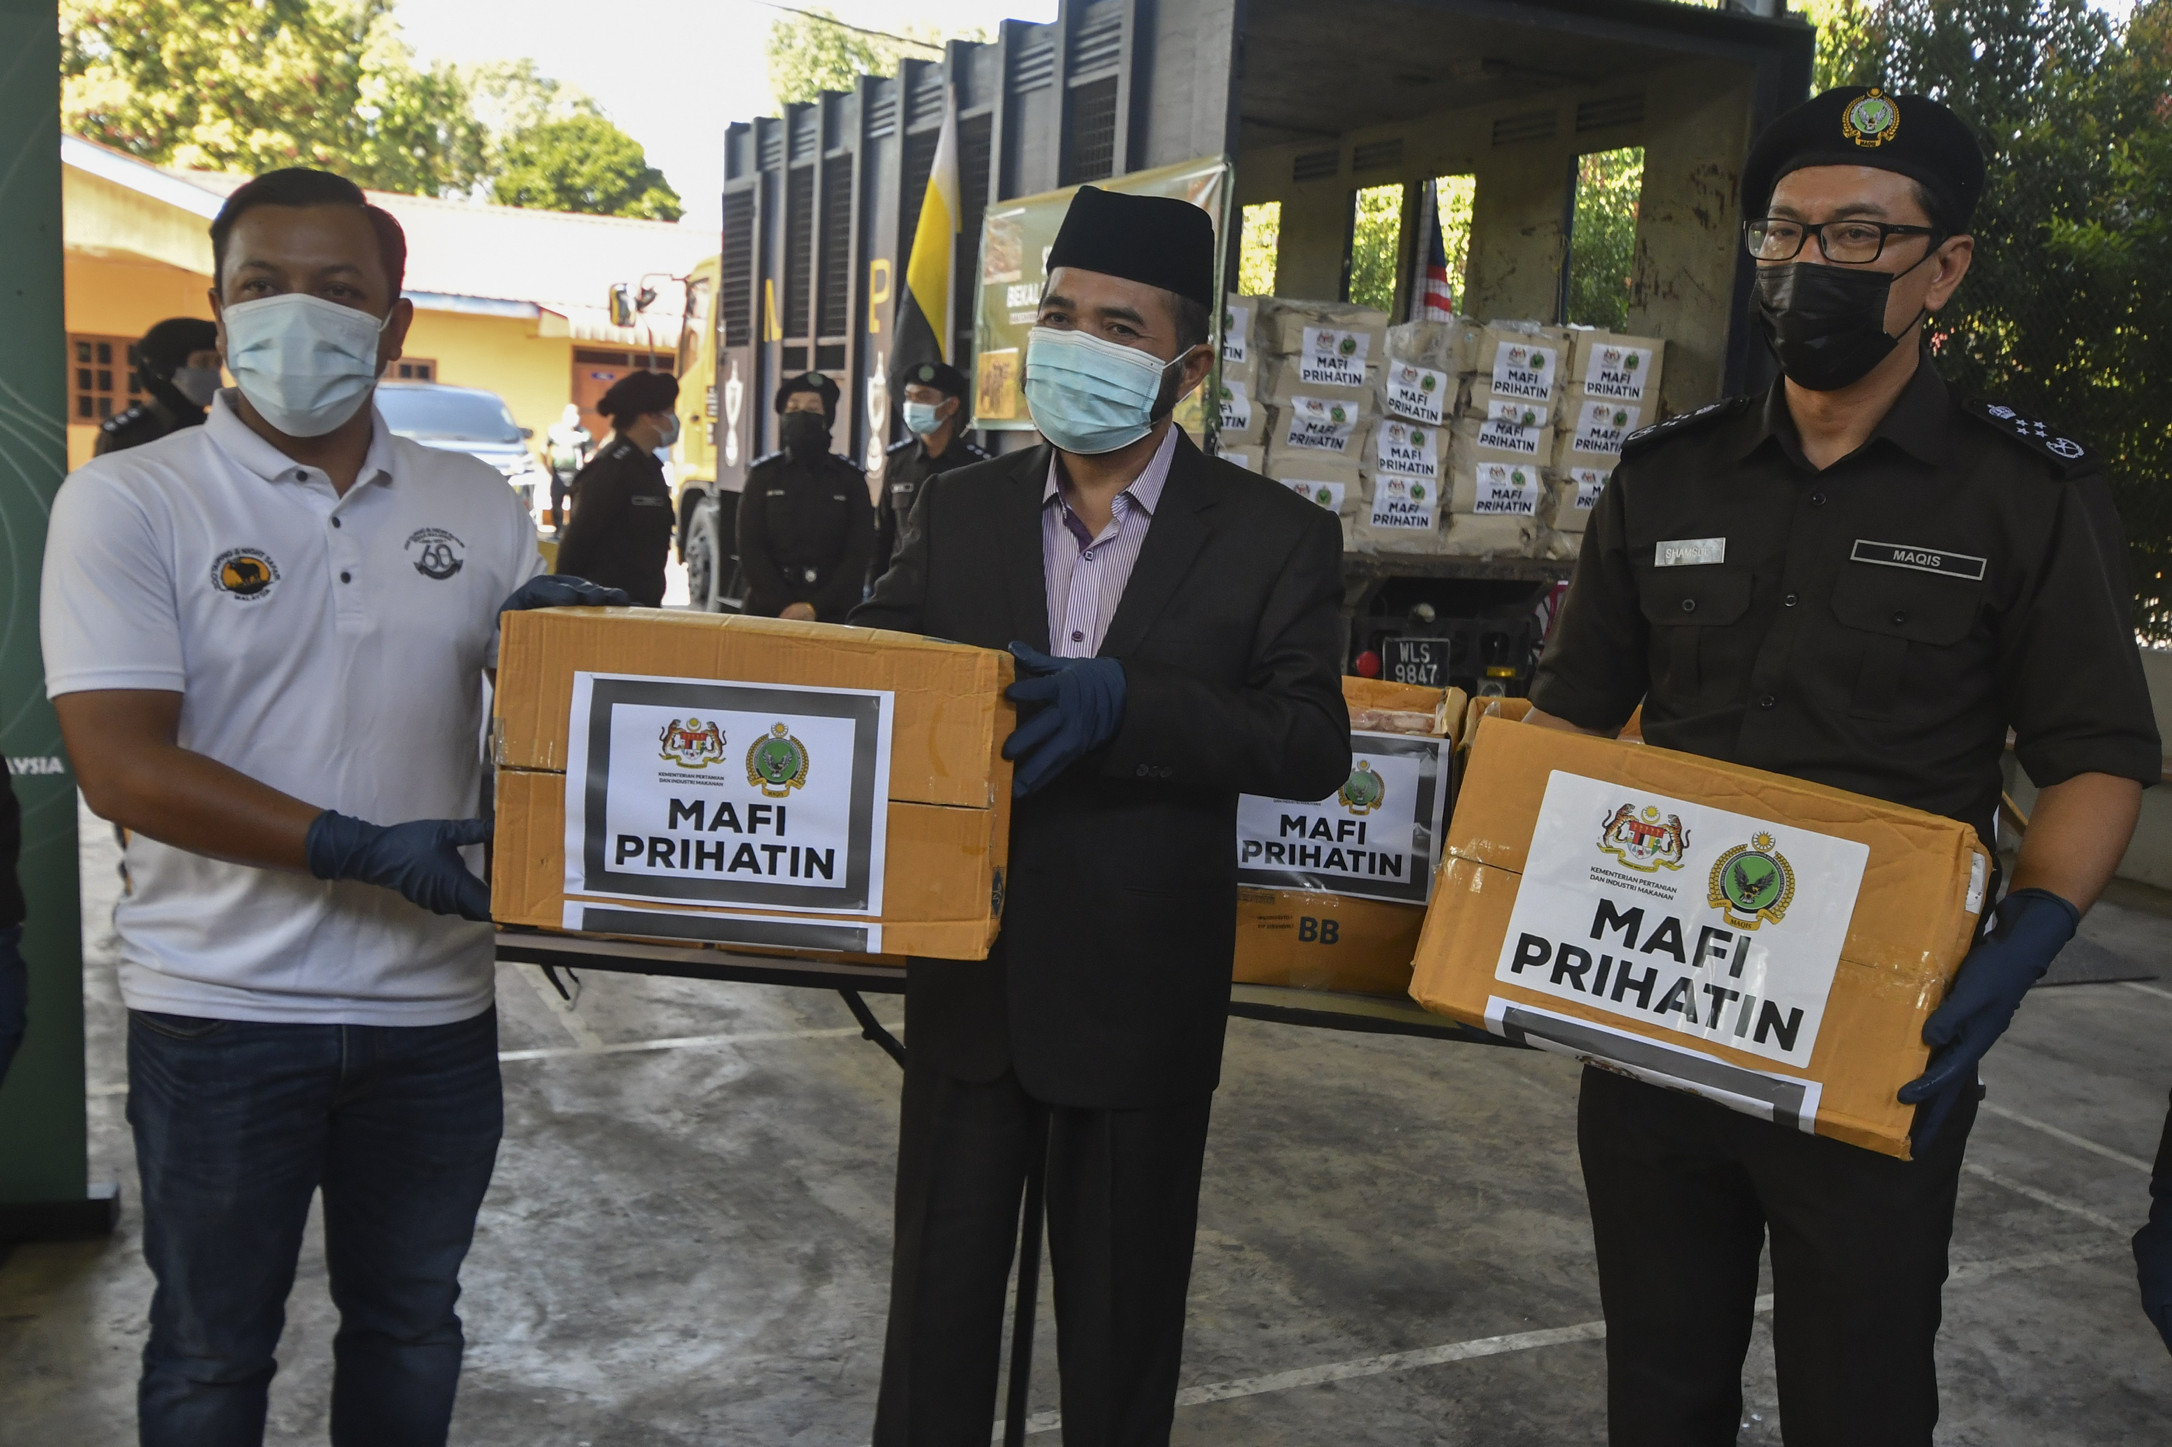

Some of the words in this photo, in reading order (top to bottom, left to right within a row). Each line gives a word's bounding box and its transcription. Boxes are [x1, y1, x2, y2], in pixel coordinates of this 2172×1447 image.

[1006, 281, 1046, 308] BEKAL
[1316, 356, 1349, 371] MAFI
[1302, 369, 1363, 386] PRIHATIN
[1508, 369, 1538, 384] MAFI
[1600, 371, 1631, 384] MAFI
[1400, 388, 1428, 406] MAFI
[1494, 382, 1549, 399] PRIHATIN
[1587, 382, 1641, 398] PRIHATIN
[1388, 398, 1440, 422] PRIHATIN
[1305, 421, 1338, 436] MAFI
[1495, 423, 1524, 438] MAFI
[1590, 427, 1620, 440] MAFI
[1288, 432, 1345, 450] PRIHATIN
[1480, 435, 1535, 452] PRIHATIN
[1390, 447, 1422, 461] MAFI
[1379, 459, 1435, 475] PRIHATIN
[1491, 488, 1522, 500] MAFI
[1388, 502, 1420, 514] MAFI
[1476, 501, 1532, 513] PRIHATIN
[1373, 513, 1429, 528] PRIHATIN
[1893, 549, 1942, 568] MAQIS
[1400, 642, 1431, 664] WLS
[1395, 664, 1438, 685] 9847
[668, 798, 786, 837] MAFI
[1280, 814, 1367, 845] MAFI
[615, 834, 835, 880] PRIHATIN
[1241, 840, 1403, 878] PRIHATIN
[1589, 874, 1606, 883] DAN
[1605, 878, 1637, 891] INDUSTRI
[1637, 887, 1674, 901] MAKANAN
[1590, 866, 1639, 884] KEMENTERIAN
[1638, 878, 1678, 894] PERTANIAN
[1298, 916, 1340, 945] BB
[1729, 918, 1752, 929] MAQIS
[1589, 897, 1752, 979] MAFI
[1510, 932, 1805, 1052] PRIHATIN
